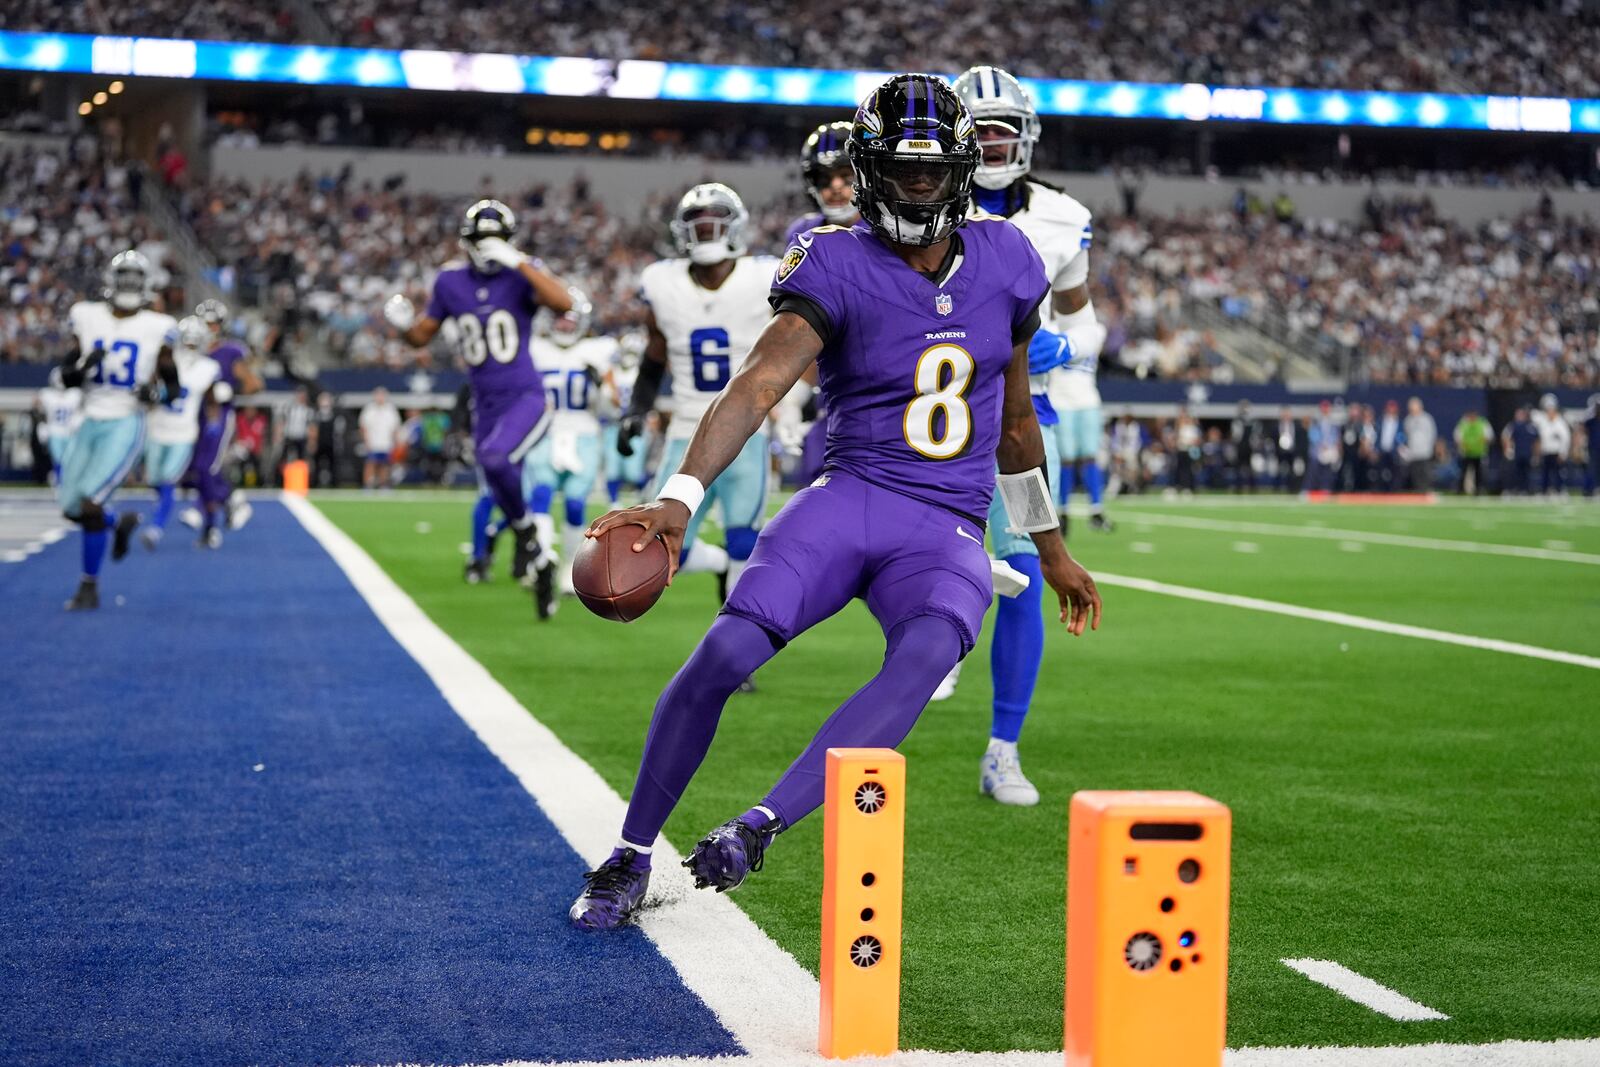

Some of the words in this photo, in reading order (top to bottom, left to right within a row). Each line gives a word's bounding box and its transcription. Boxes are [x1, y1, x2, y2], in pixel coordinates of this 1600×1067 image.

[908, 141, 932, 149] RAVENS
[457, 310, 519, 366] 80
[690, 327, 730, 392] 6
[925, 331, 967, 340] RAVENS
[93, 339, 138, 388] 13
[903, 343, 976, 459] 8
